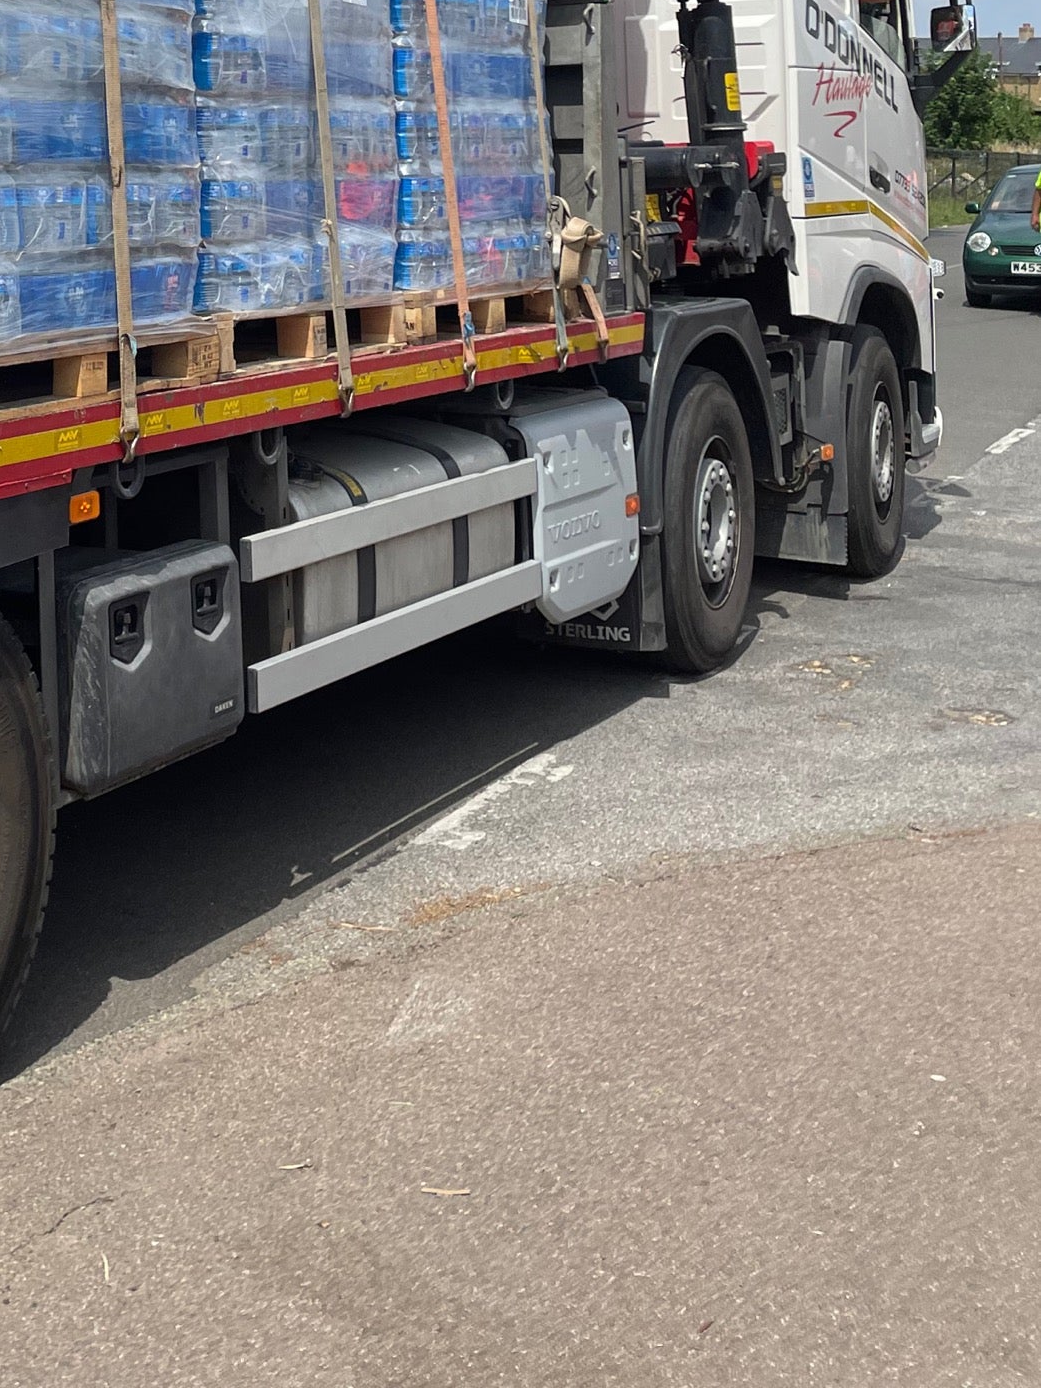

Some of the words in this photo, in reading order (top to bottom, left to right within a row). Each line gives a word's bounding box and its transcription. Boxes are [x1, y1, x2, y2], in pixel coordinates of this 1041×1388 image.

[812, 62, 873, 113] Haulage
[546, 510, 601, 544] VOLVO
[546, 622, 631, 643] STERLING
